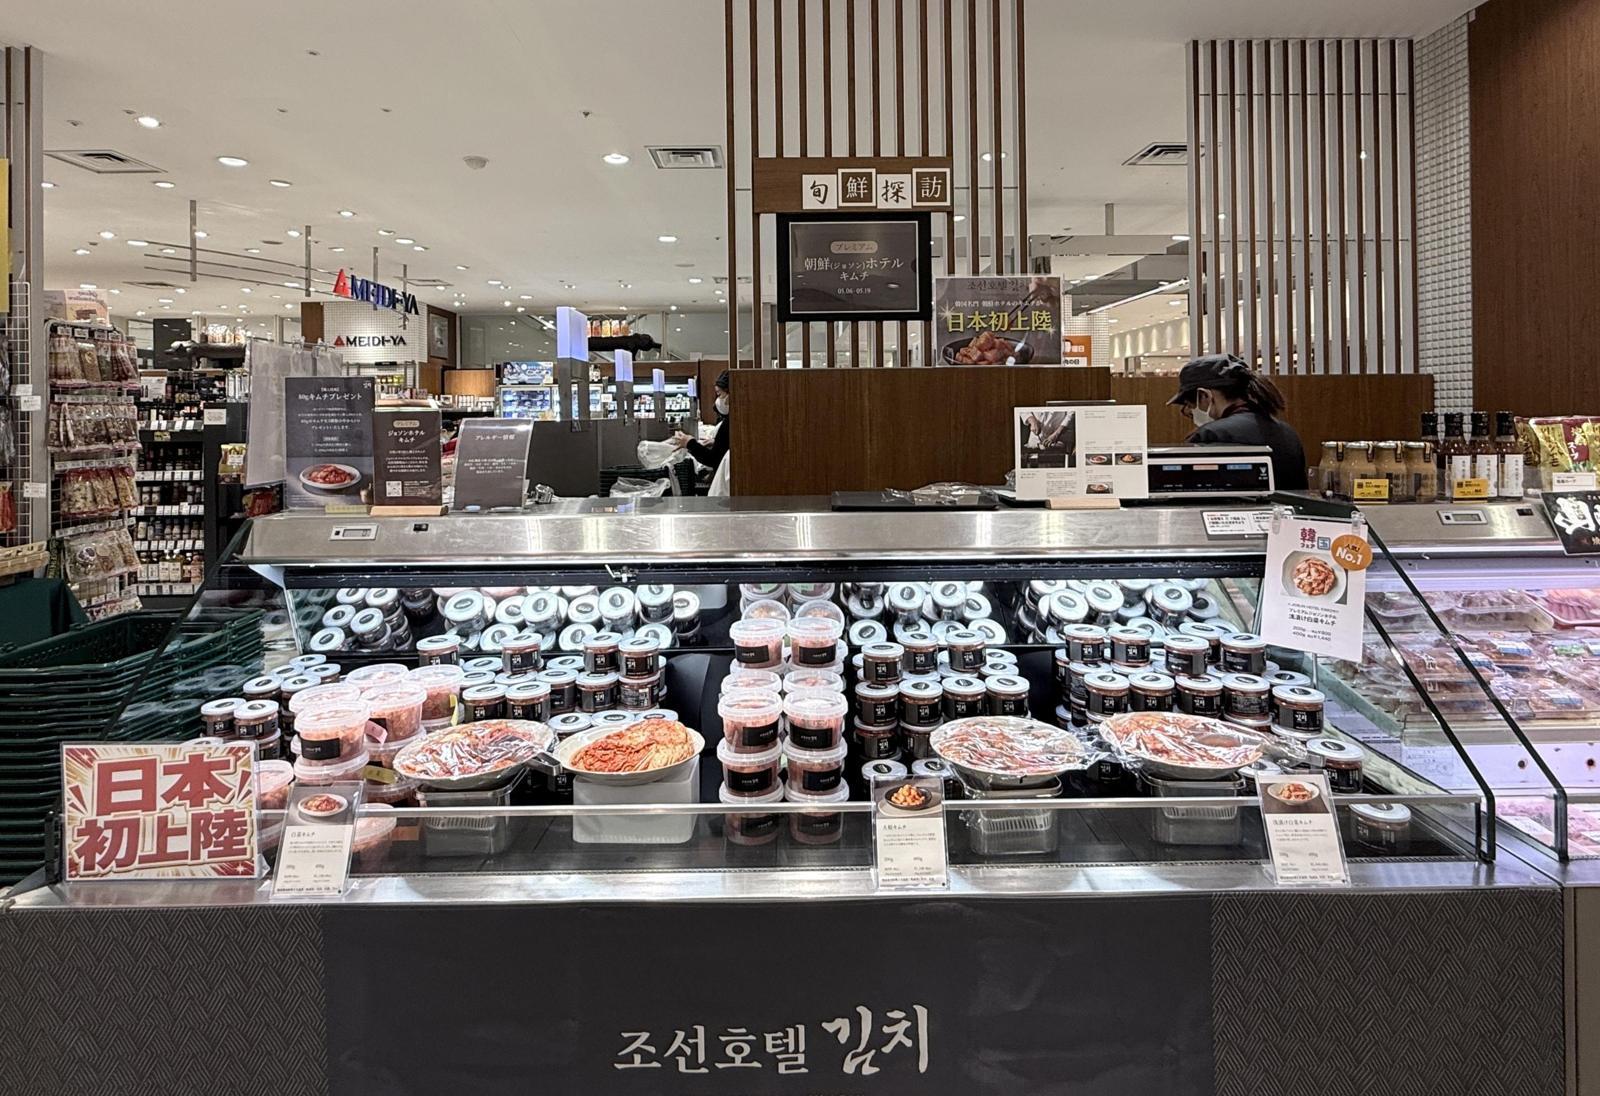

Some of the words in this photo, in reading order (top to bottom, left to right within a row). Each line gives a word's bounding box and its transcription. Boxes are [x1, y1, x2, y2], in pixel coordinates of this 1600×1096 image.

[810, 176, 942, 204] 旬鮮探訪
[836, 243, 873, 251] プレミアム
[840, 271, 869, 281] キムチ
[351, 274, 419, 315] MEIDI-YA
[947, 310, 1051, 332] 日本初上陸
[346, 335, 406, 347] MEIDI-YA
[1336, 547, 1363, 565] No.1
[95, 753, 234, 816] 日本
[75, 809, 248, 871] 初上陸
[613, 1024, 809, 1075] 조선호텔
[821, 1004, 928, 1076] 김치
